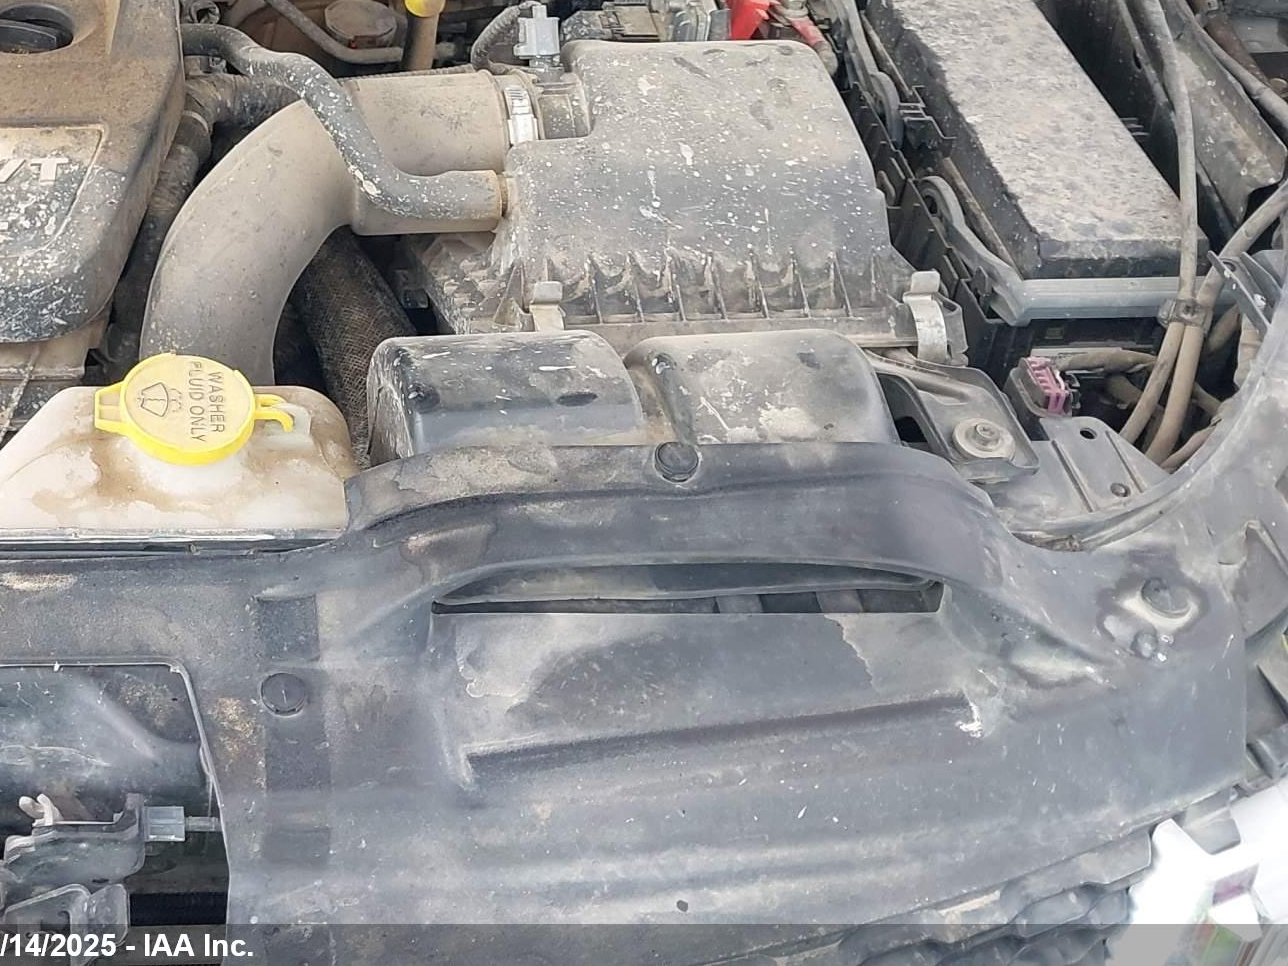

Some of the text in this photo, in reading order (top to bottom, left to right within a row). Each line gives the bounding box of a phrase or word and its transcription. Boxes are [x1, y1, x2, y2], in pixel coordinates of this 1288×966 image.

[188, 361, 208, 443] FLUID ONLY
[208, 371, 226, 434] WASHER
